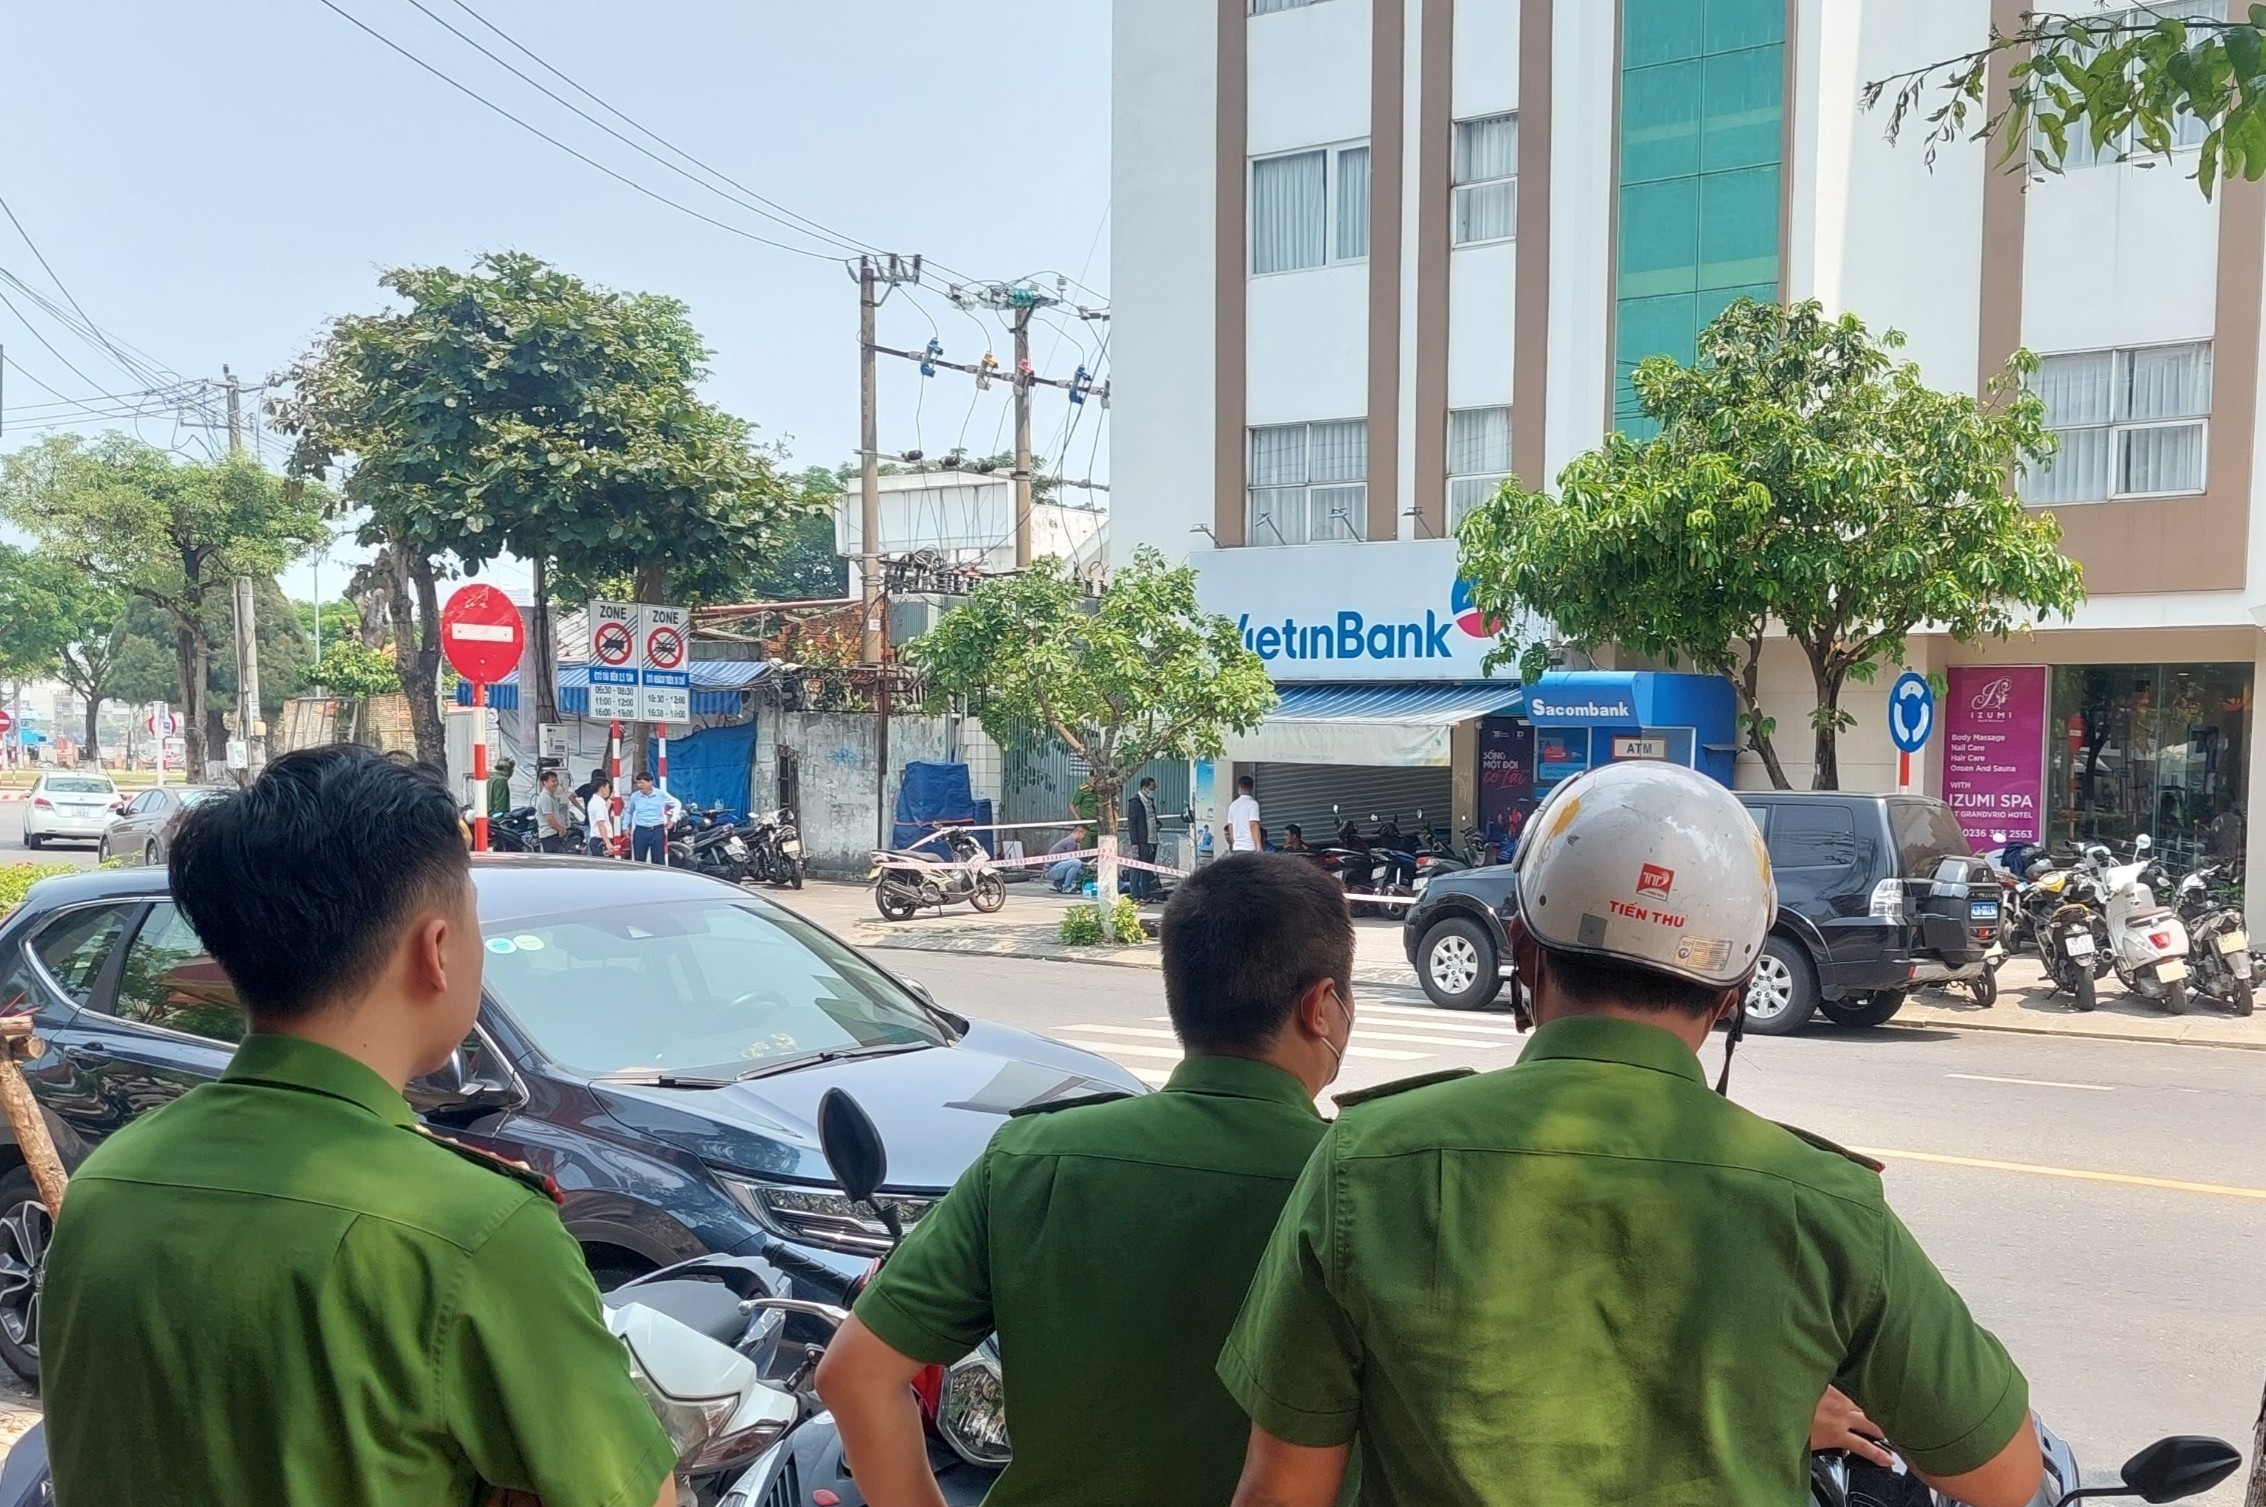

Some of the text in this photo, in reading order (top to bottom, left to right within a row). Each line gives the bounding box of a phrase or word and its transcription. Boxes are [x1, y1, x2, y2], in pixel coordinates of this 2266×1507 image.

[600, 605, 627, 620] ZONE
[652, 610, 679, 624] ZONE
[1532, 698, 1630, 718] Sacombank
[1970, 711, 2012, 719] IZUMI
[1951, 733, 2006, 743] Body Massage
[1626, 742, 1653, 755] ATM
[1951, 744, 1966, 752] Nail
[1483, 750, 1506, 760] SỐNG
[1483, 759, 1518, 770] MỘT ĐỜI
[1950, 781, 1971, 789] WITH
[1948, 794, 2033, 808] IZUMI SPA
[2008, 811, 2033, 819] HOTEL
[1962, 828, 1987, 838] 0236
[2008, 829, 2033, 839] 2563
[1610, 900, 1687, 928] TIẾN THU
